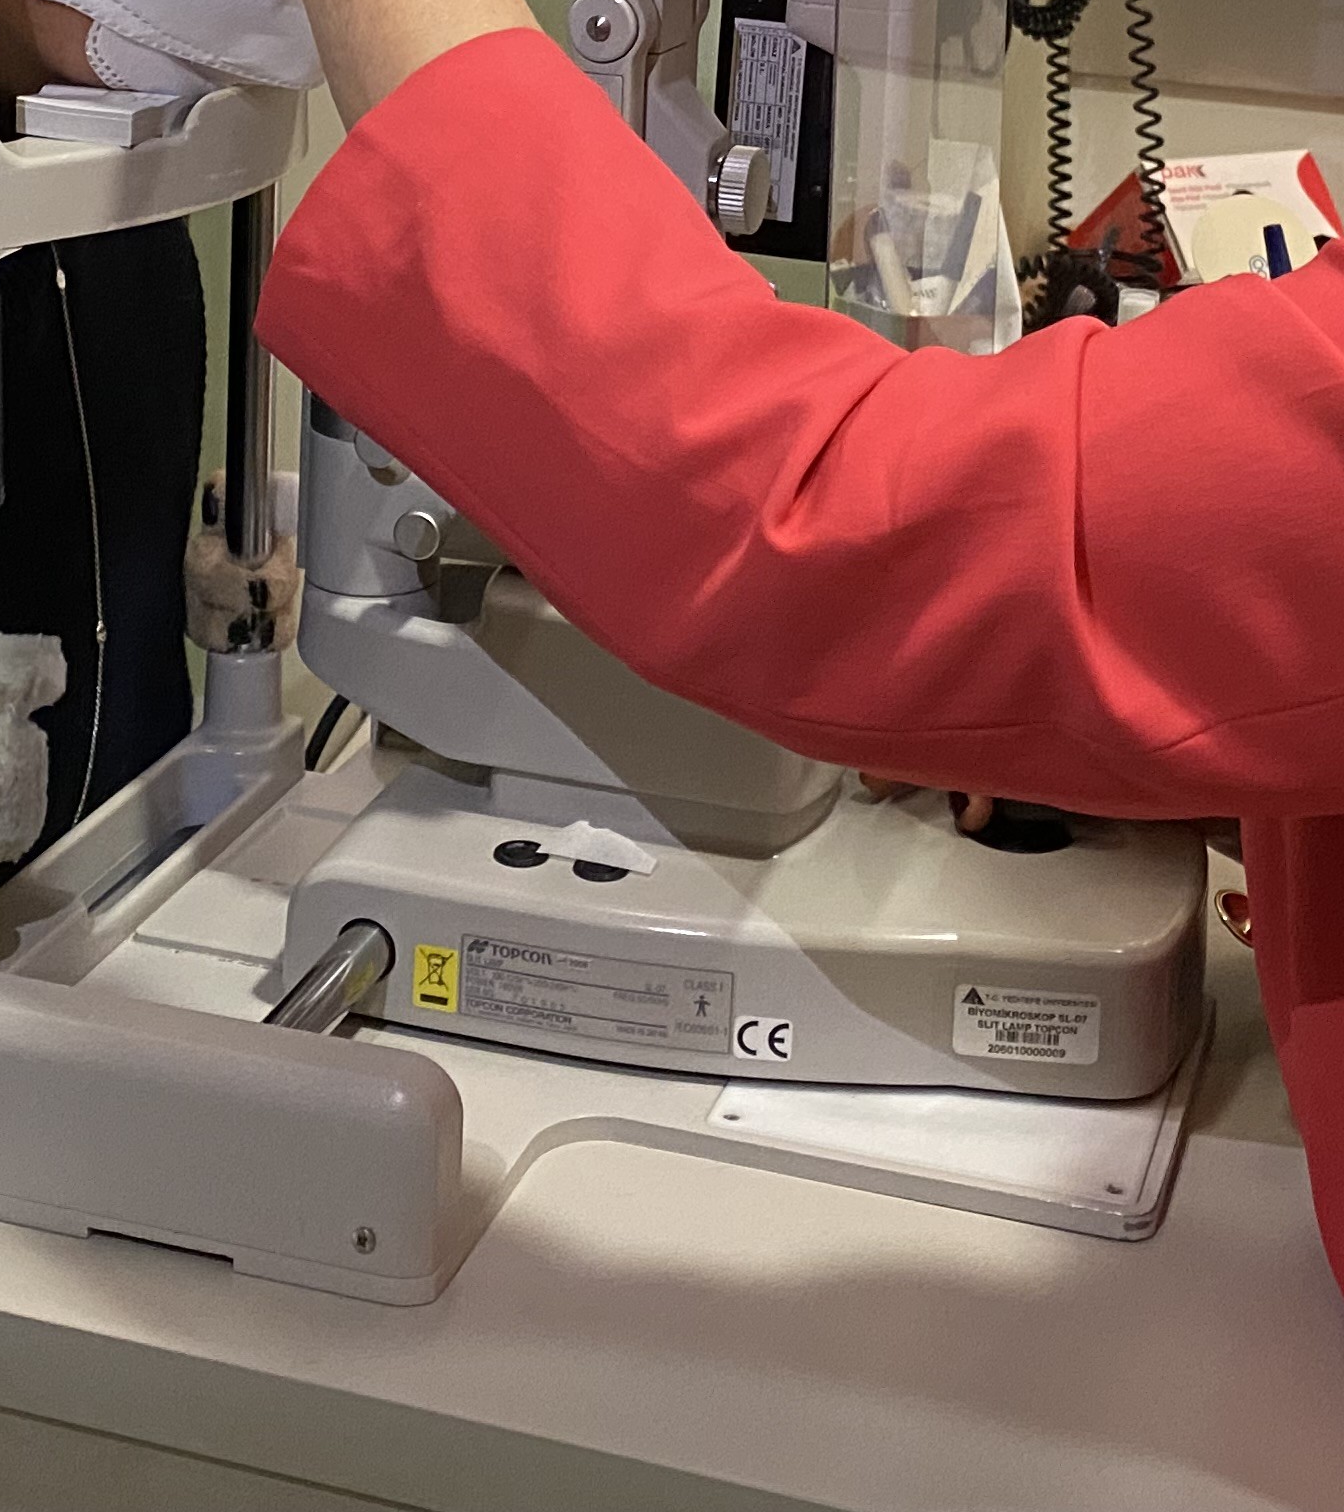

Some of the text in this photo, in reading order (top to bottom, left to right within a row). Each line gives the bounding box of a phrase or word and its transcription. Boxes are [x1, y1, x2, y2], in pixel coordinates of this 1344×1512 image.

[490, 944, 553, 966] TOPCON
[737, 1020, 790, 1059] CE
[1035, 1023, 1078, 1035] TOPCON
